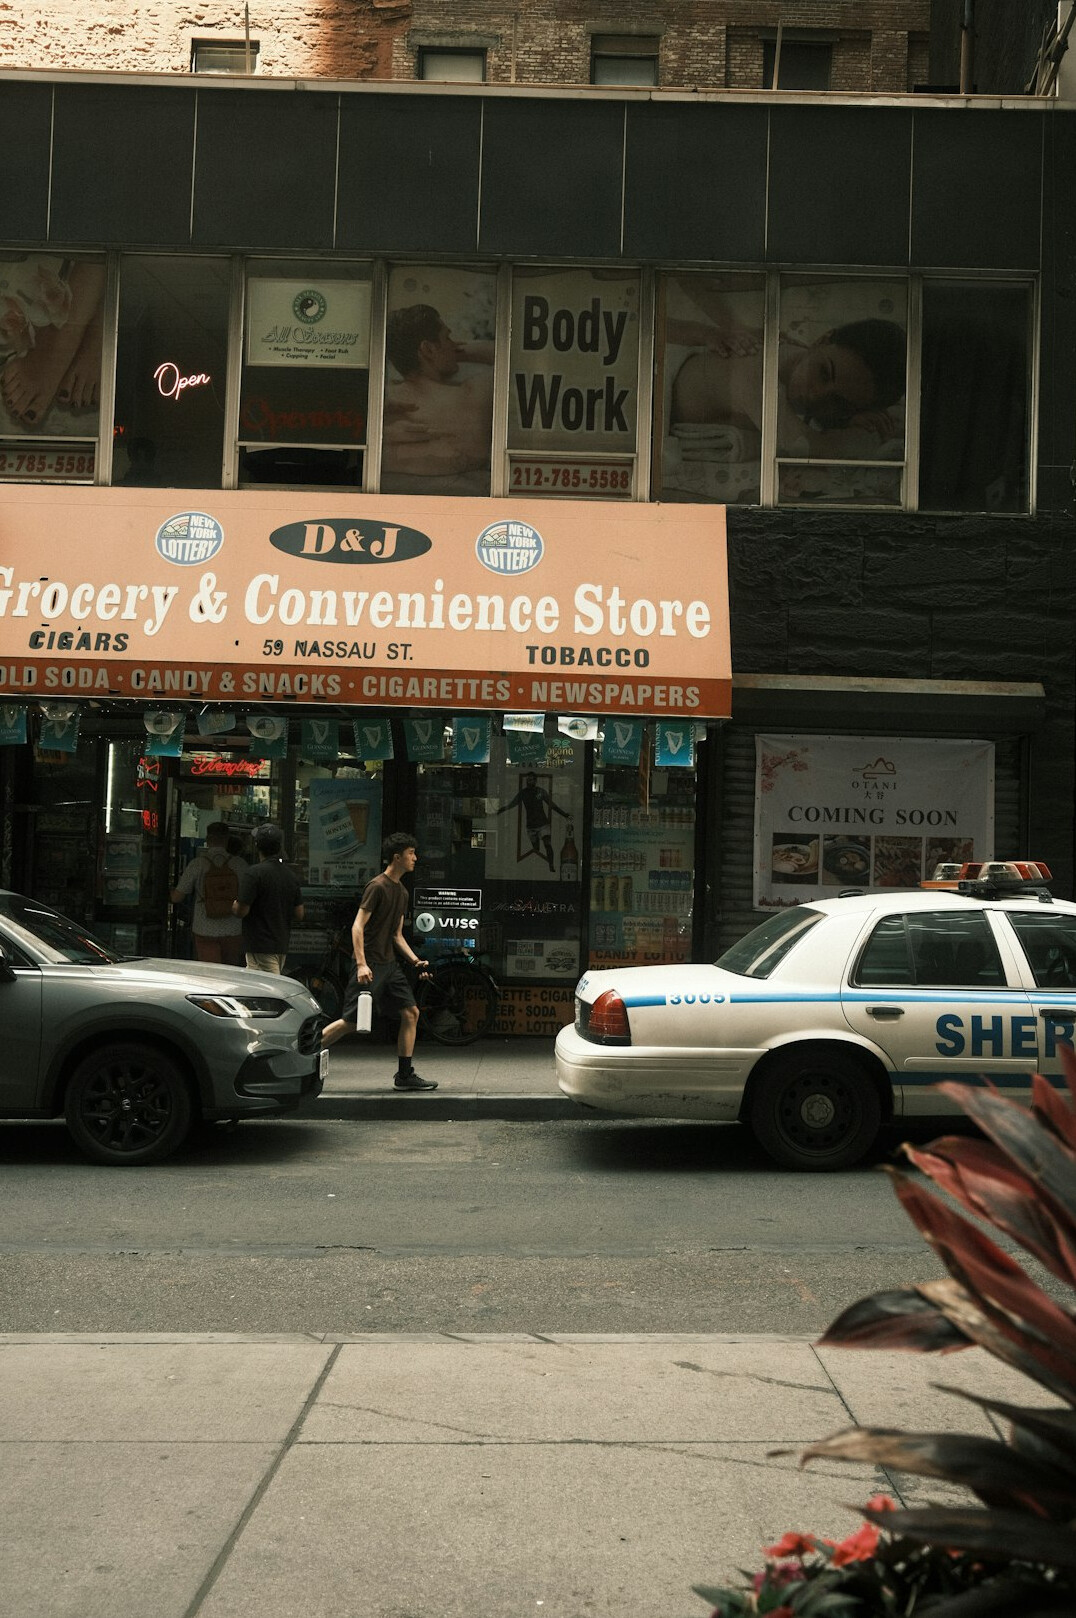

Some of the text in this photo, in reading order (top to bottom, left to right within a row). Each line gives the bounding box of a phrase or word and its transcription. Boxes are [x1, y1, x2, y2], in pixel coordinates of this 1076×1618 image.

[261, 326, 291, 343] All
[523, 295, 628, 366] Body
[154, 362, 210, 400] Open
[515, 373, 630, 432] Work
[512, 466, 629, 489] 212-785-5588
[189, 526, 217, 539] YORK
[190, 515, 215, 529] NEW
[508, 524, 533, 538] NEW
[161, 539, 218, 561] LOTTERY
[508, 535, 537, 548] YORK
[481, 548, 539, 571] LOTTERY
[189, 572, 228, 624] &
[245, 573, 559, 634] Convenience
[574, 583, 711, 638] Store
[28, 630, 129, 652] CIGARS
[262, 639, 413, 661] 59 NASSAU ST.
[526, 645, 650, 668] TOBACCO
[45, 666, 110, 689] SODA
[131, 669, 212, 692] CANDY
[219, 671, 236, 693] &
[243, 671, 341, 695] SNACKS
[362, 675, 511, 702] CIGARETTES
[531, 681, 700, 708] NEWSPAPERS
[546, 747, 574, 757] orona
[851, 781, 897, 790] OTANI
[863, 791, 885, 800] 大谷
[788, 805, 958, 826] COMING SOON
[670, 992, 726, 1006] 3005
[485, 1004, 557, 1018] EER SODA
[477, 1019, 516, 1032] CNDY
[935, 1013, 1076, 1058] SHER
